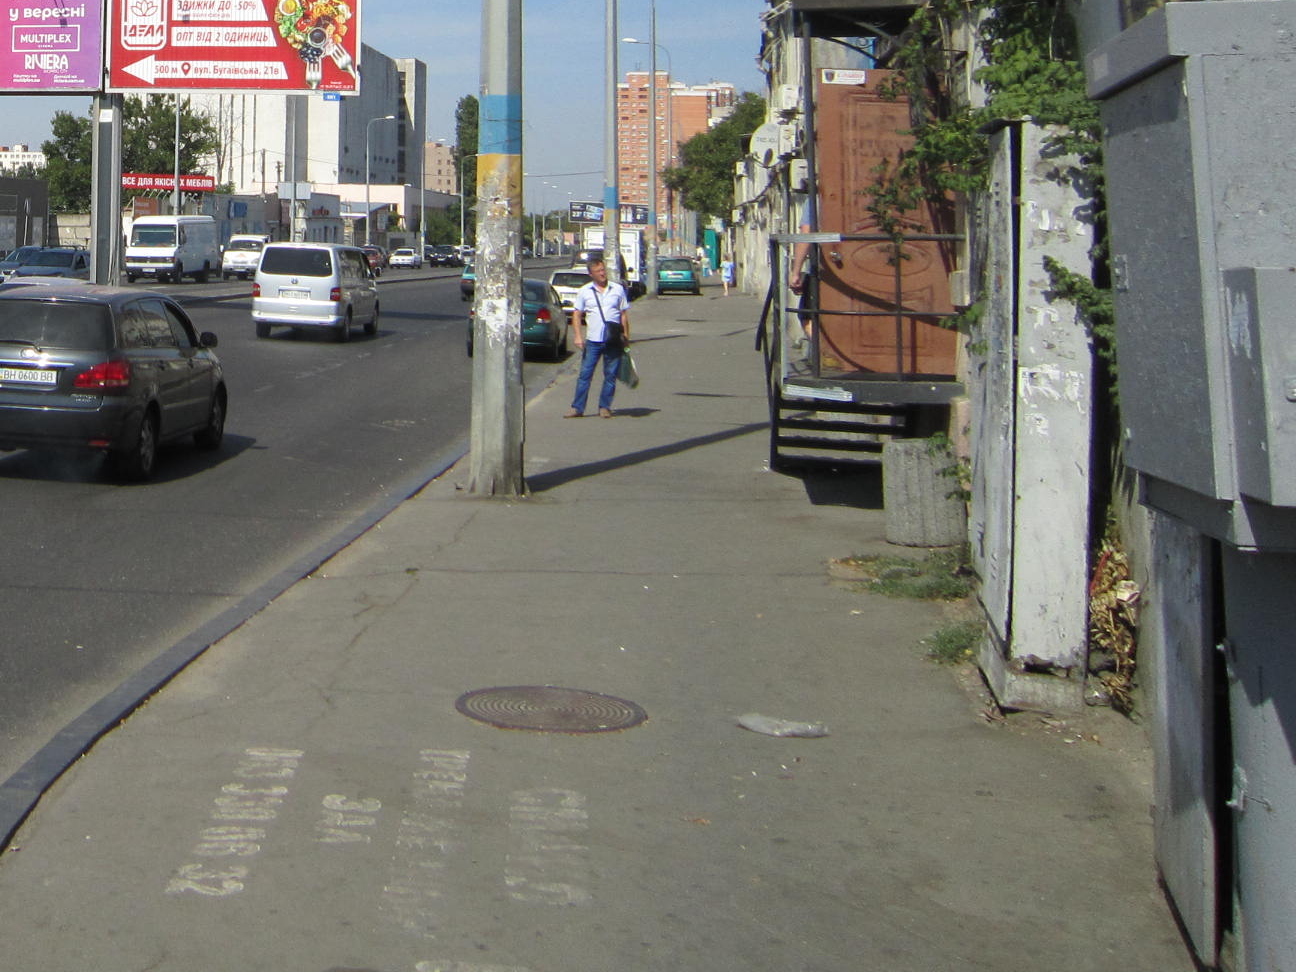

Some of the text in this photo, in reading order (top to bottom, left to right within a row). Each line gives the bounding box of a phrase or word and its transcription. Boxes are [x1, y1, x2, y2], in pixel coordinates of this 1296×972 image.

[177, 0, 257, 12] ЗНИЖКИ ДО -50%
[9, 4, 85, 22] у вересні
[20, 34, 72, 44] MULTIPLEX
[176, 31, 269, 44] ОПТ ВІД 2 ОДИНИЦЬ
[24, 54, 69, 70] RIVIERA
[154, 65, 170, 74] 500
[194, 68, 211, 76] вул.
[264, 65, 279, 75] 21в
[122, 176, 213, 188] ВСЕ ДЛЯ ЯКІСНХ МЕБЛІВ
